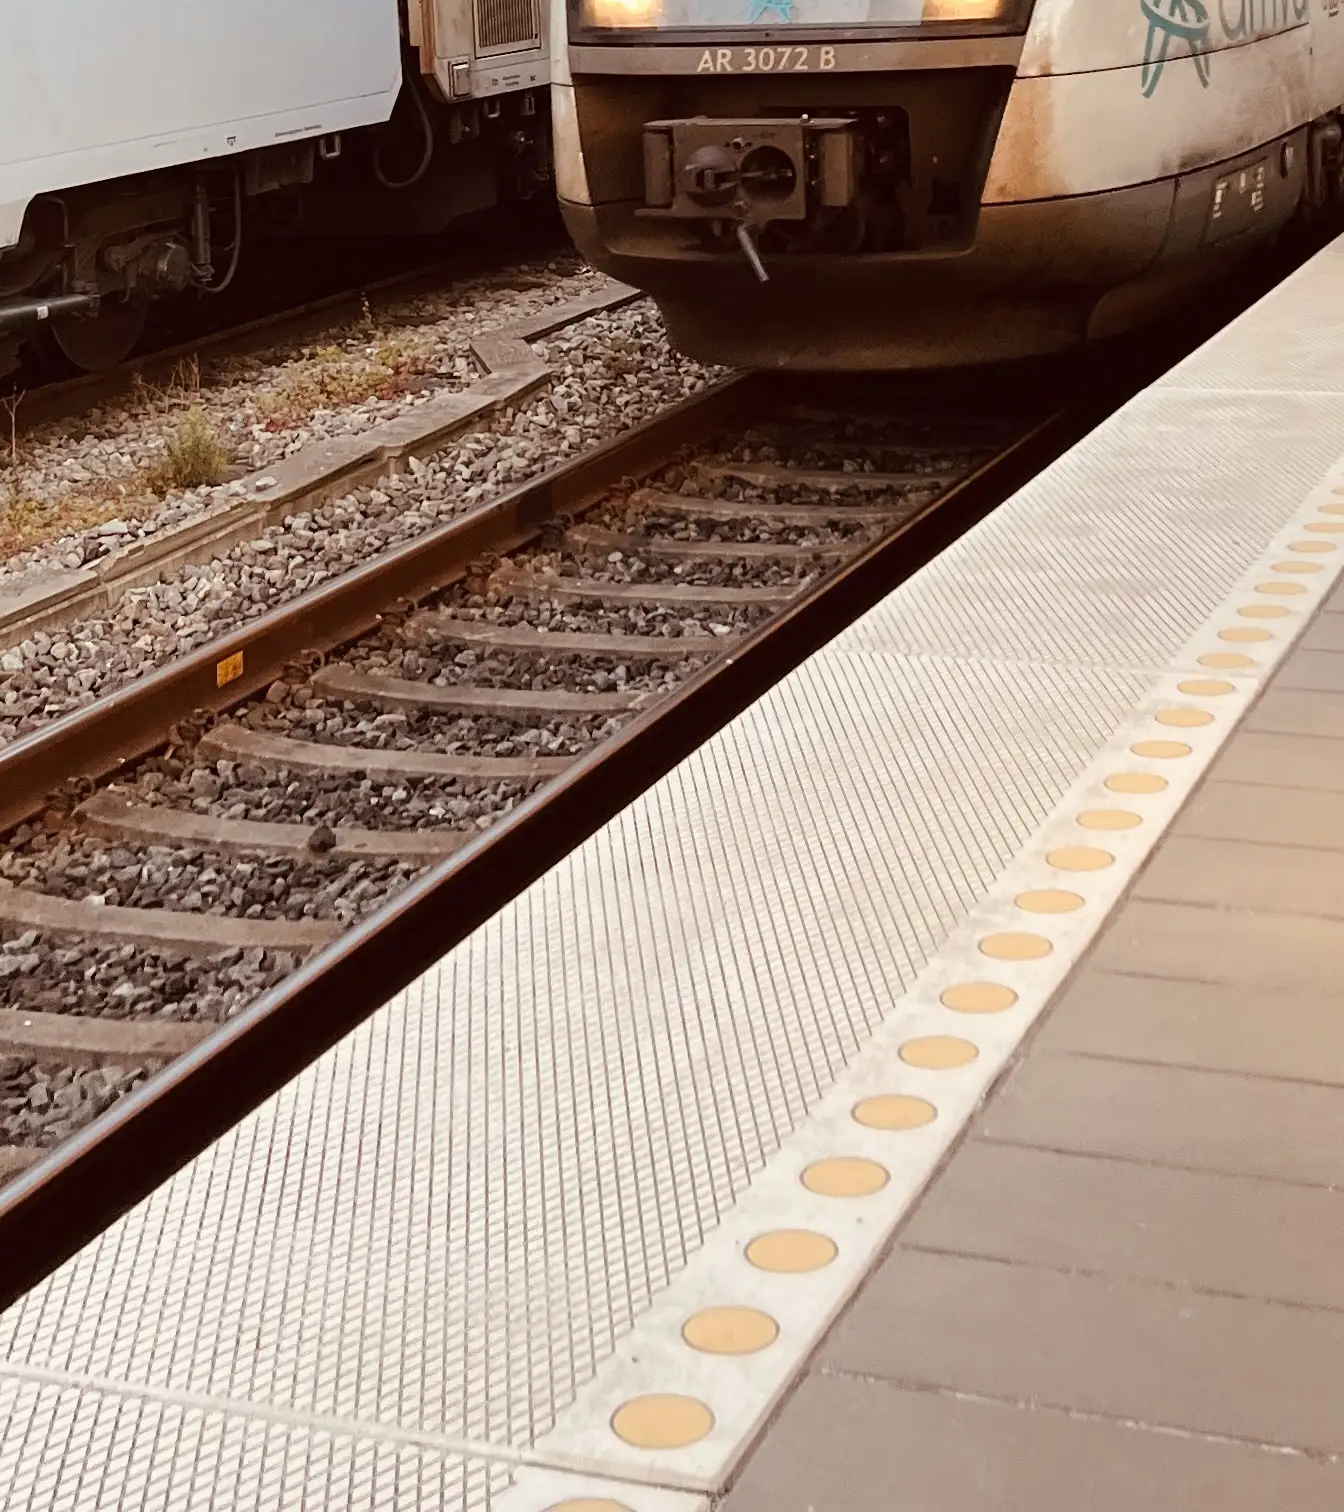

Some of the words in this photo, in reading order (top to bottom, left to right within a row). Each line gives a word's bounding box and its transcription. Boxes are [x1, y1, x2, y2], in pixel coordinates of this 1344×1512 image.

[697, 49, 733, 72] AR
[742, 47, 808, 71] 3072
[819, 46, 836, 70] B
